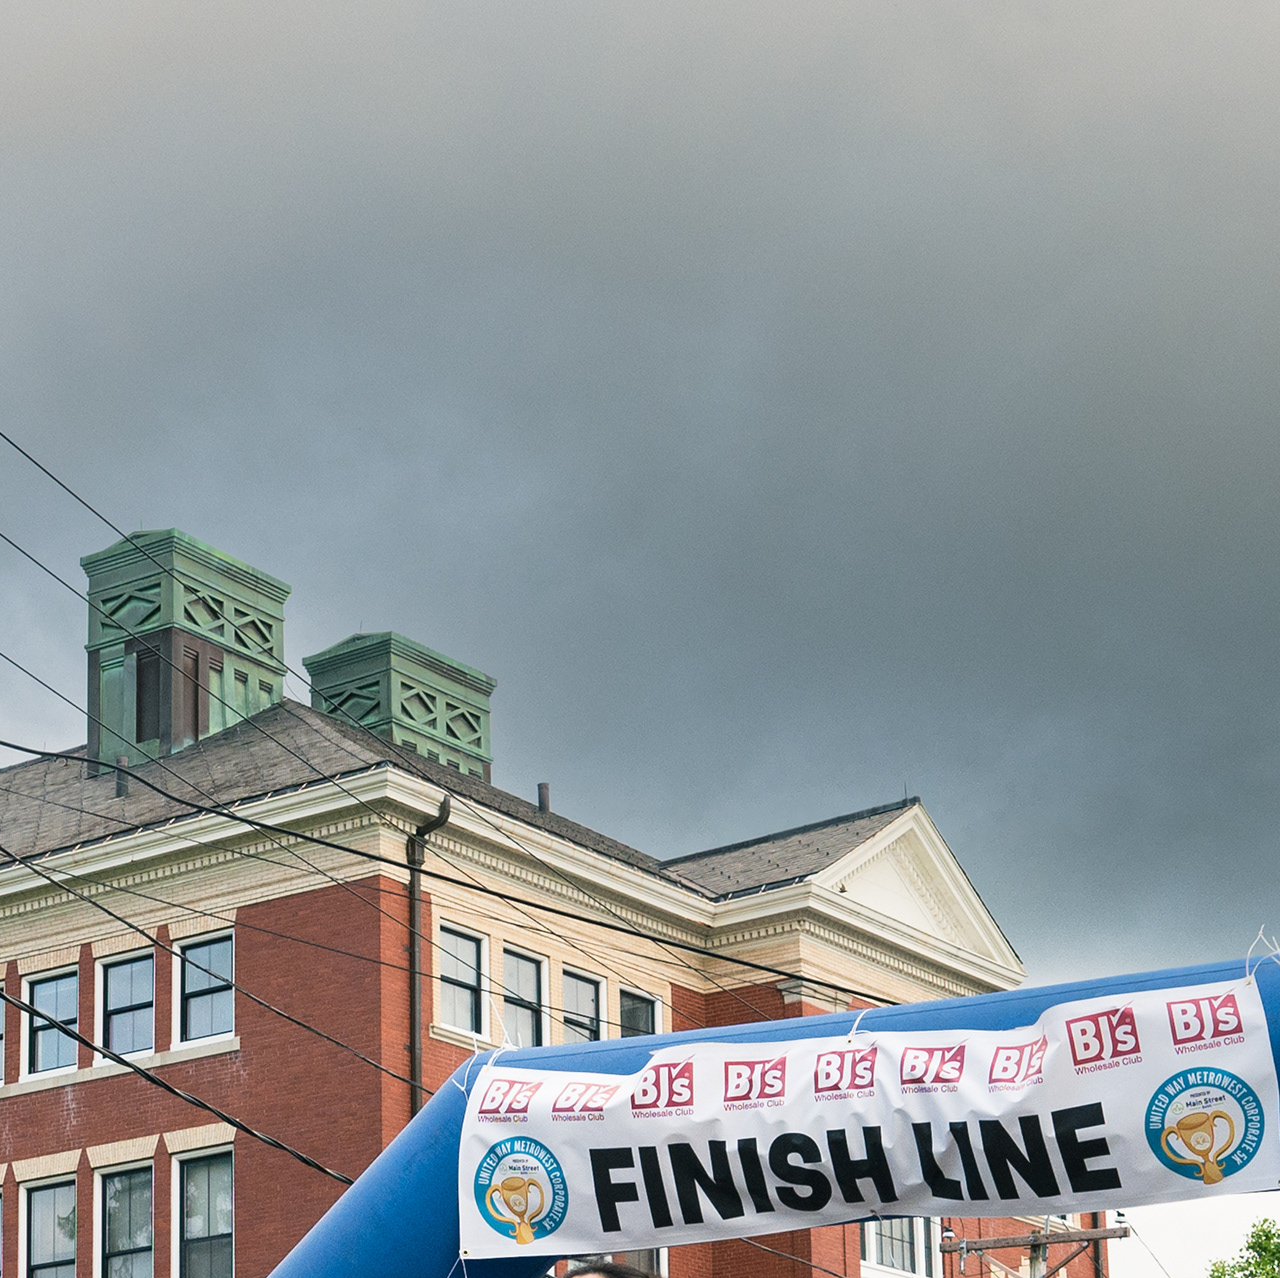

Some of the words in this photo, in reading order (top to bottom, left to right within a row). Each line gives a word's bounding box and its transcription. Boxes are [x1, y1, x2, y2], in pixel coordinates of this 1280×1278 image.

[1174, 1039, 1222, 1055] Wholesale
[1223, 1034, 1245, 1047] Club
[1074, 1060, 1121, 1076] Wholesale
[1122, 1054, 1143, 1066] Club
[901, 1086, 938, 1094] Wholesale
[940, 1085, 958, 1093] Club
[1164, 1076, 1187, 1097] WAY
[1187, 1071, 1248, 1098] METROWEST
[723, 1101, 765, 1111] Wholesale
[766, 1098, 785, 1107] Club
[814, 1092, 855, 1102] Wholesale
[857, 1090, 875, 1098] Club
[1186, 1099, 1202, 1108] Main
[1203, 1094, 1226, 1104] Street
[478, 1115, 511, 1123] Wholesale
[552, 1114, 586, 1122] Wholesale
[632, 1109, 673, 1119] Wholesale
[674, 1108, 694, 1116] Club
[1149, 1093, 1170, 1130] UNITED
[1240, 1096, 1261, 1153] CORPORATE
[1231, 1150, 1248, 1165] 5K
[588, 1124, 900, 1233] FINISH
[911, 1101, 1123, 1202] LINE
[477, 1152, 500, 1185] UNITED
[493, 1141, 512, 1158] WAY
[513, 1139, 558, 1172] METROWEST
[549, 1170, 566, 1222] CORPORATE
